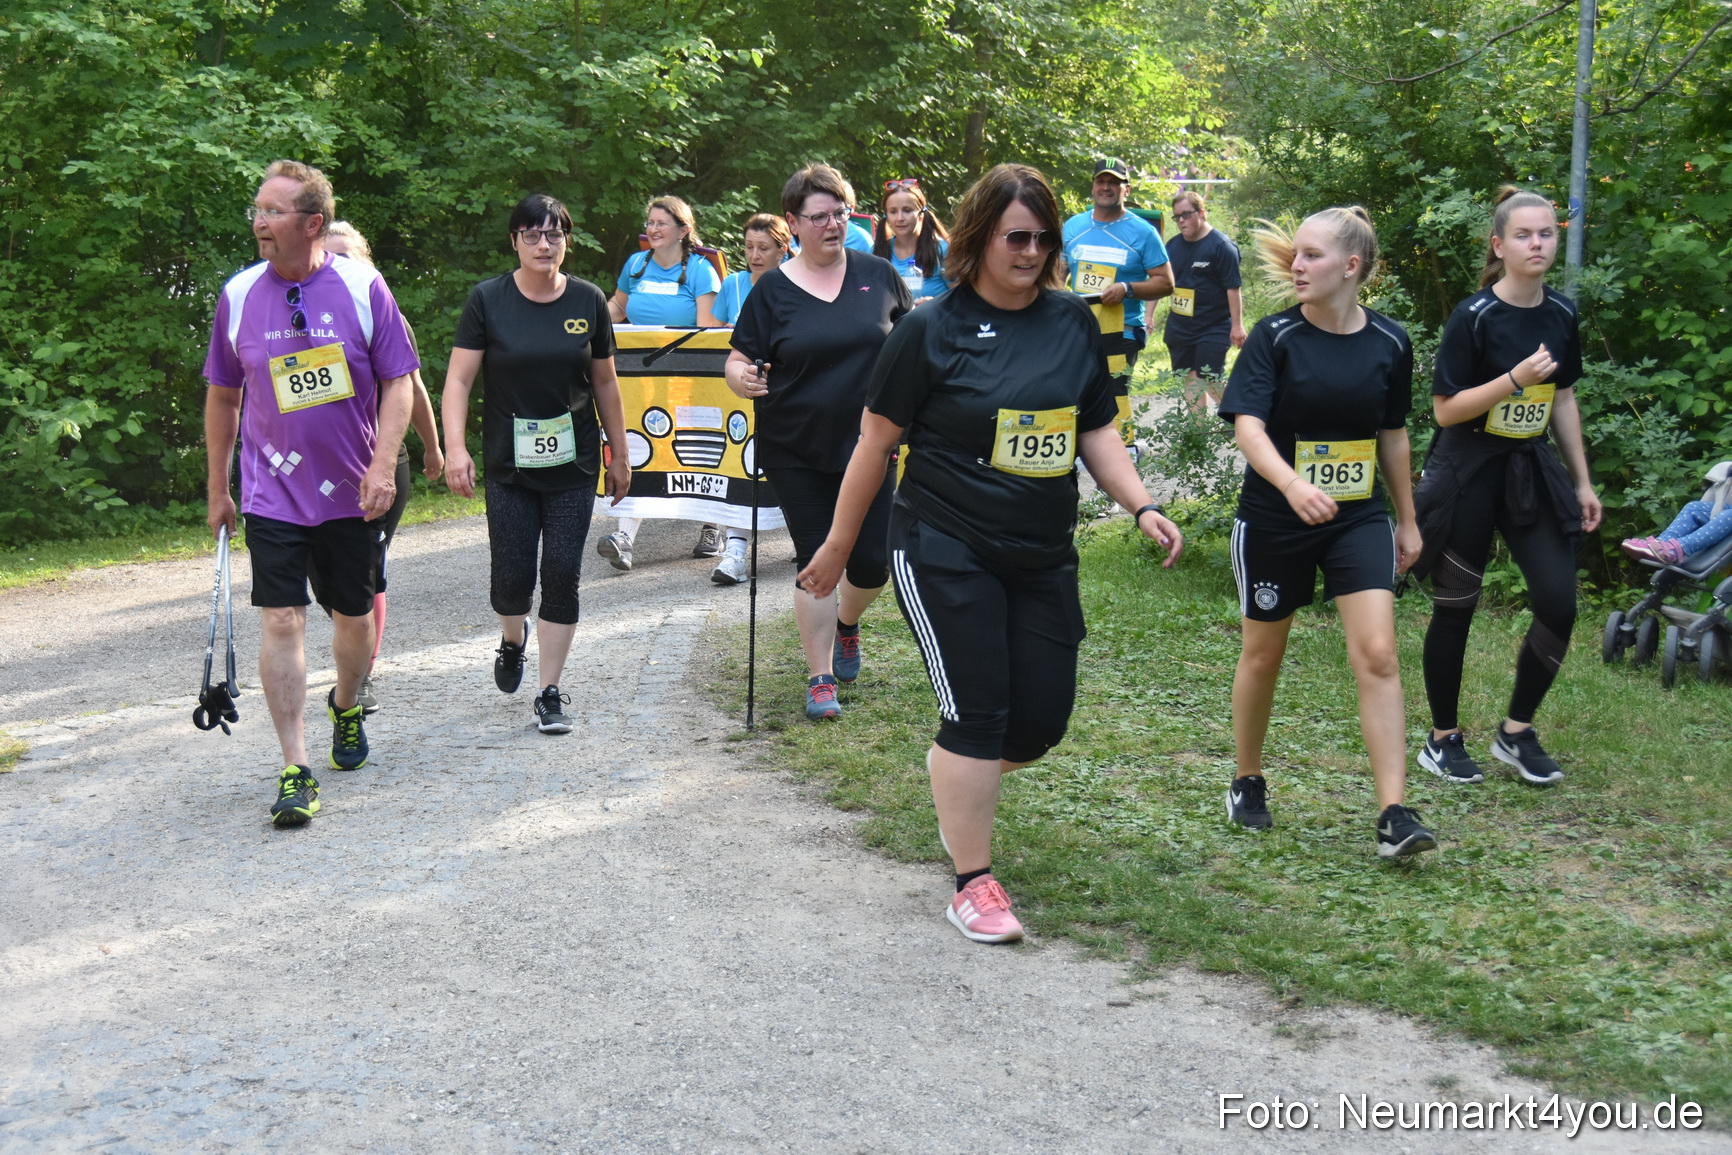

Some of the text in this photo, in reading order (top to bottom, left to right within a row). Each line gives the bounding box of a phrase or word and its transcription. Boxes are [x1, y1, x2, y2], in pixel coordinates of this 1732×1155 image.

[1083, 274, 1104, 287] 837
[264, 331, 281, 340] WIR
[311, 328, 338, 338] LILA.
[289, 367, 332, 394] 898
[1501, 404, 1546, 423] 1985
[534, 436, 558, 454] 59
[1008, 433, 1066, 458] 1953
[1041, 459, 1054, 467] Anja
[1306, 462, 1363, 484] 1963
[672, 475, 712, 494] NM-GS
